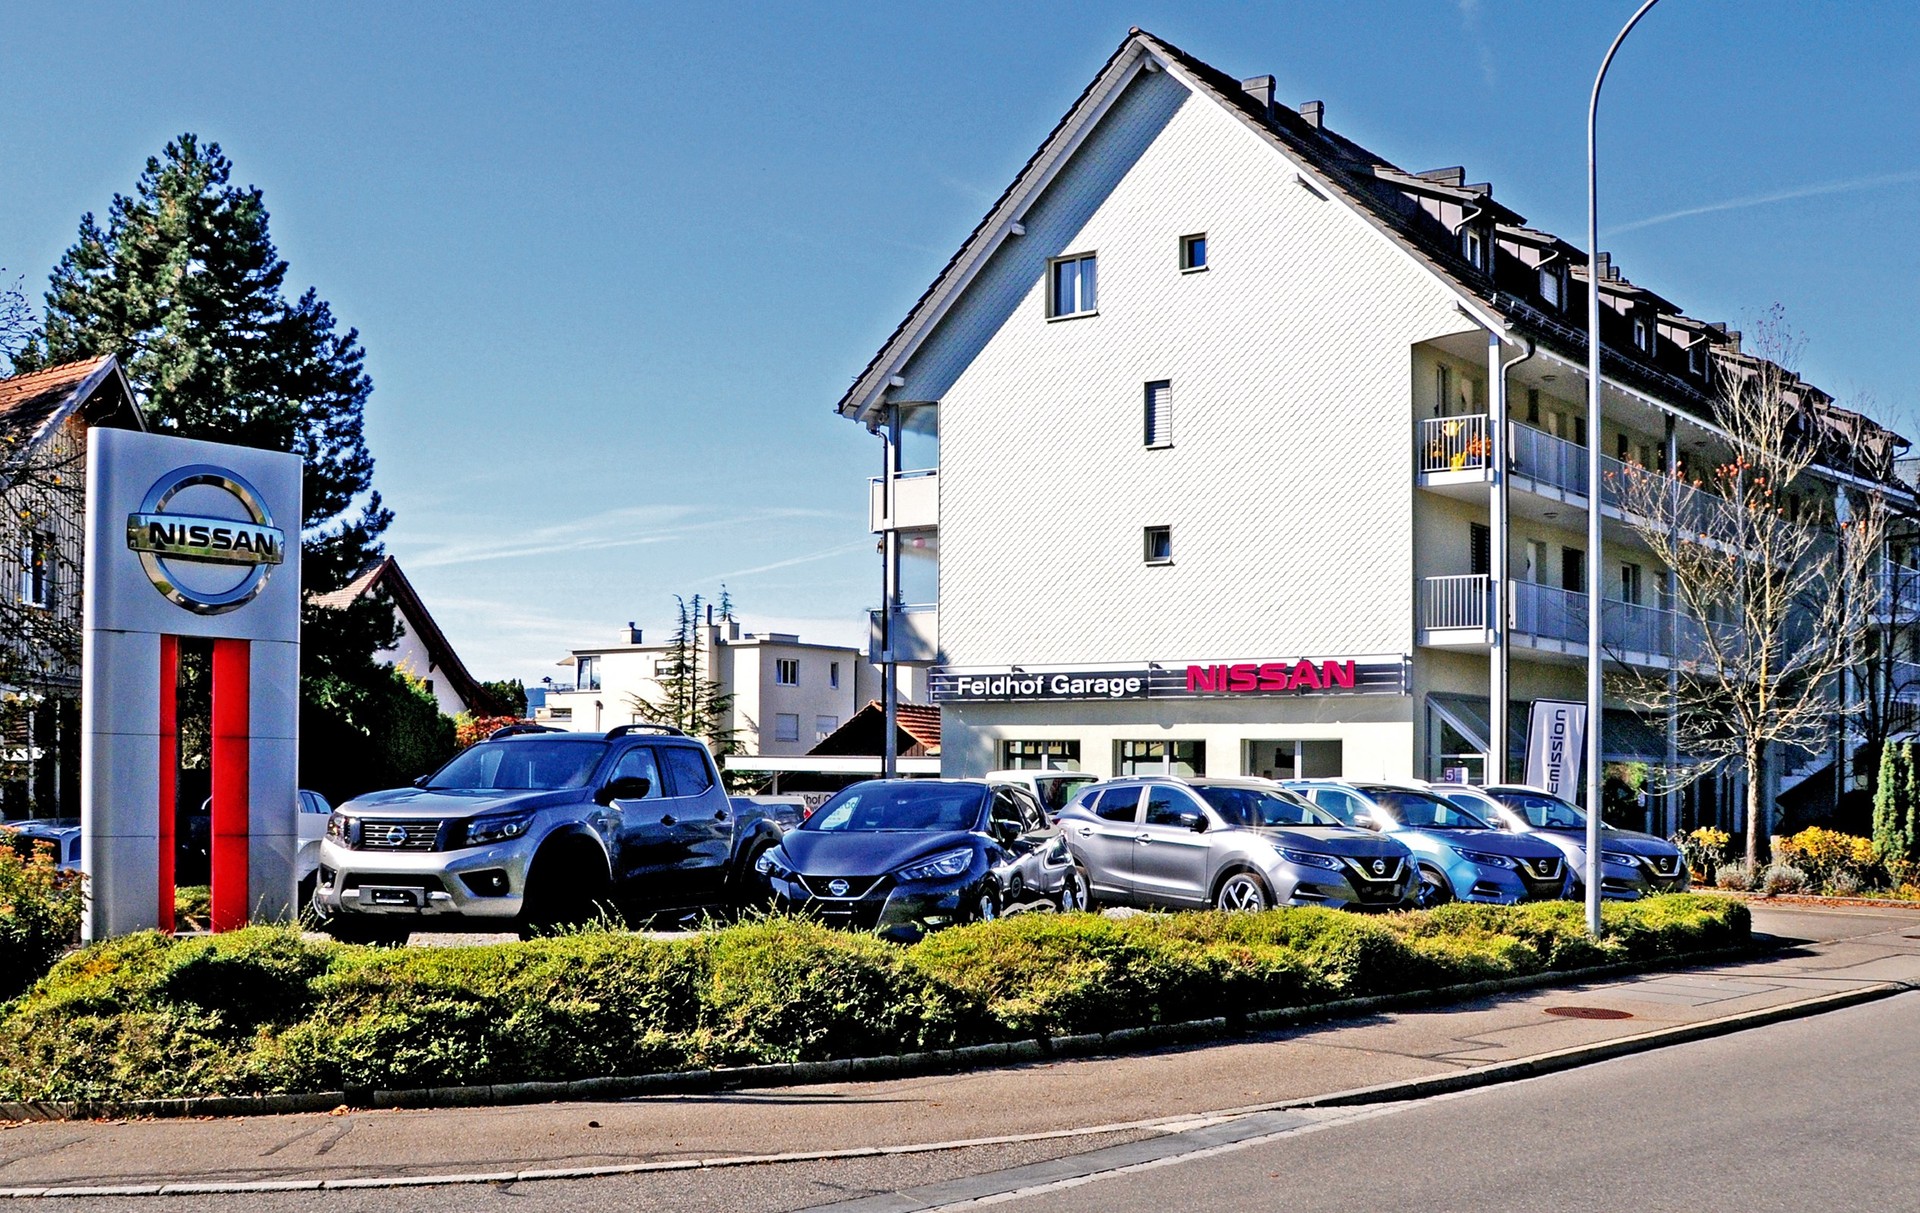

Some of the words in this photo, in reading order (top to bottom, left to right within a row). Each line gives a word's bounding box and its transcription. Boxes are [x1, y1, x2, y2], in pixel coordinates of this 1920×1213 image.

[149, 521, 274, 556] NISSAN
[957, 675, 1044, 696] Feldhof
[1050, 674, 1141, 698] Garage
[1186, 659, 1356, 693] NISSAN
[1547, 708, 1566, 795] Emission
